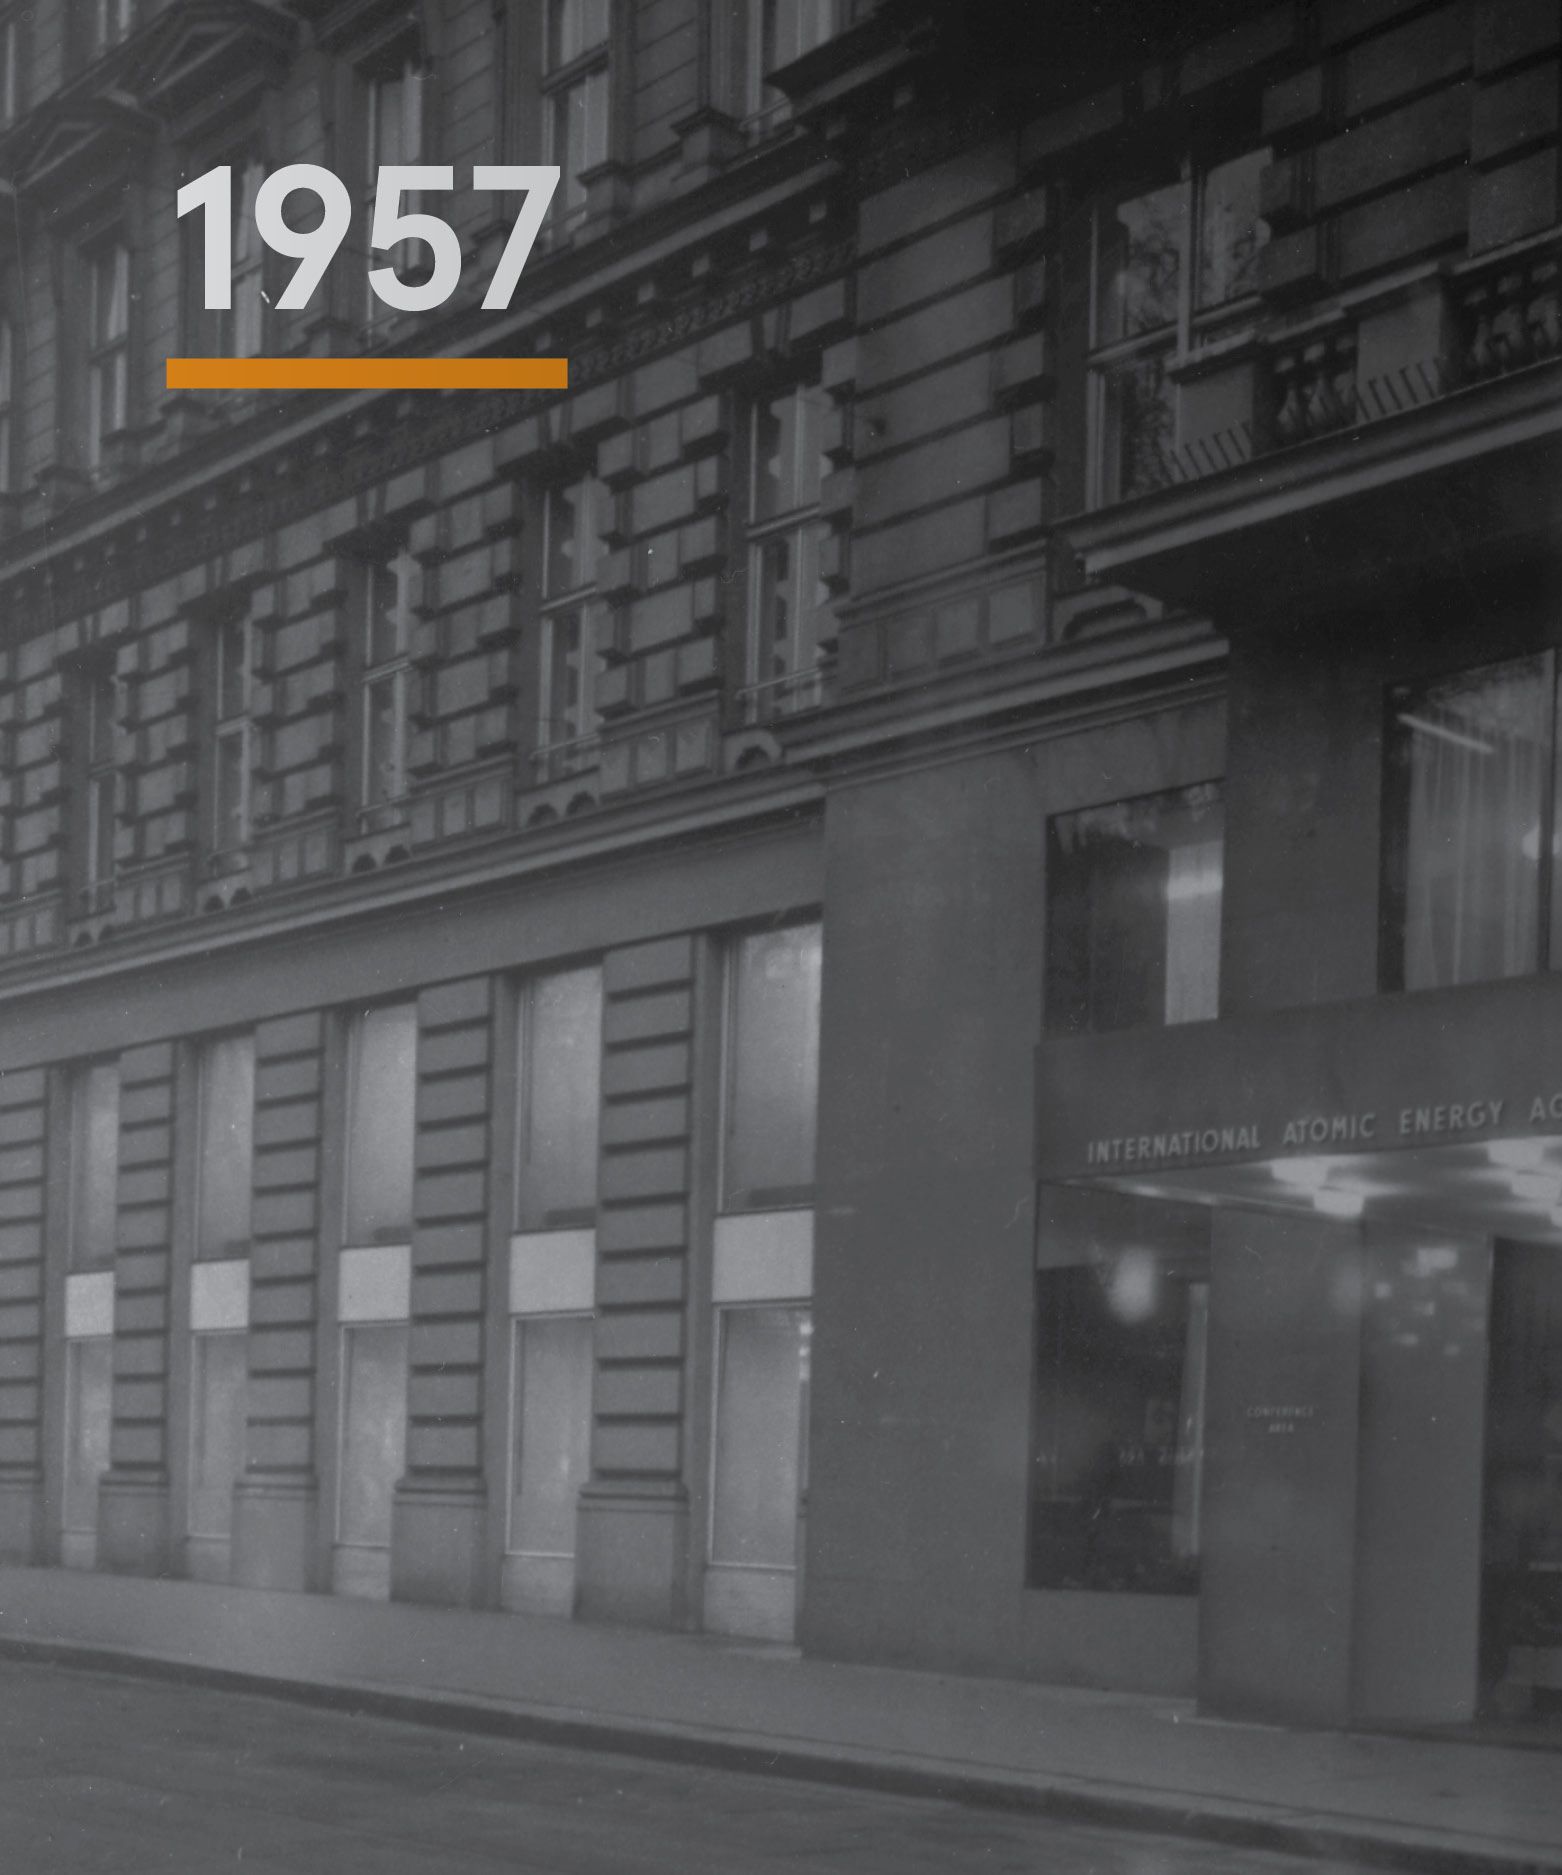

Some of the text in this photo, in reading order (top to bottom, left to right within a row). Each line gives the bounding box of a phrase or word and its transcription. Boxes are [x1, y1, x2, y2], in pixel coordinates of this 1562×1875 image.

[1087, 1123, 1261, 1164] INTERNATIONAL
[1282, 1111, 1377, 1146] ATOMIC
[1399, 1099, 1504, 1135] ENERGY
